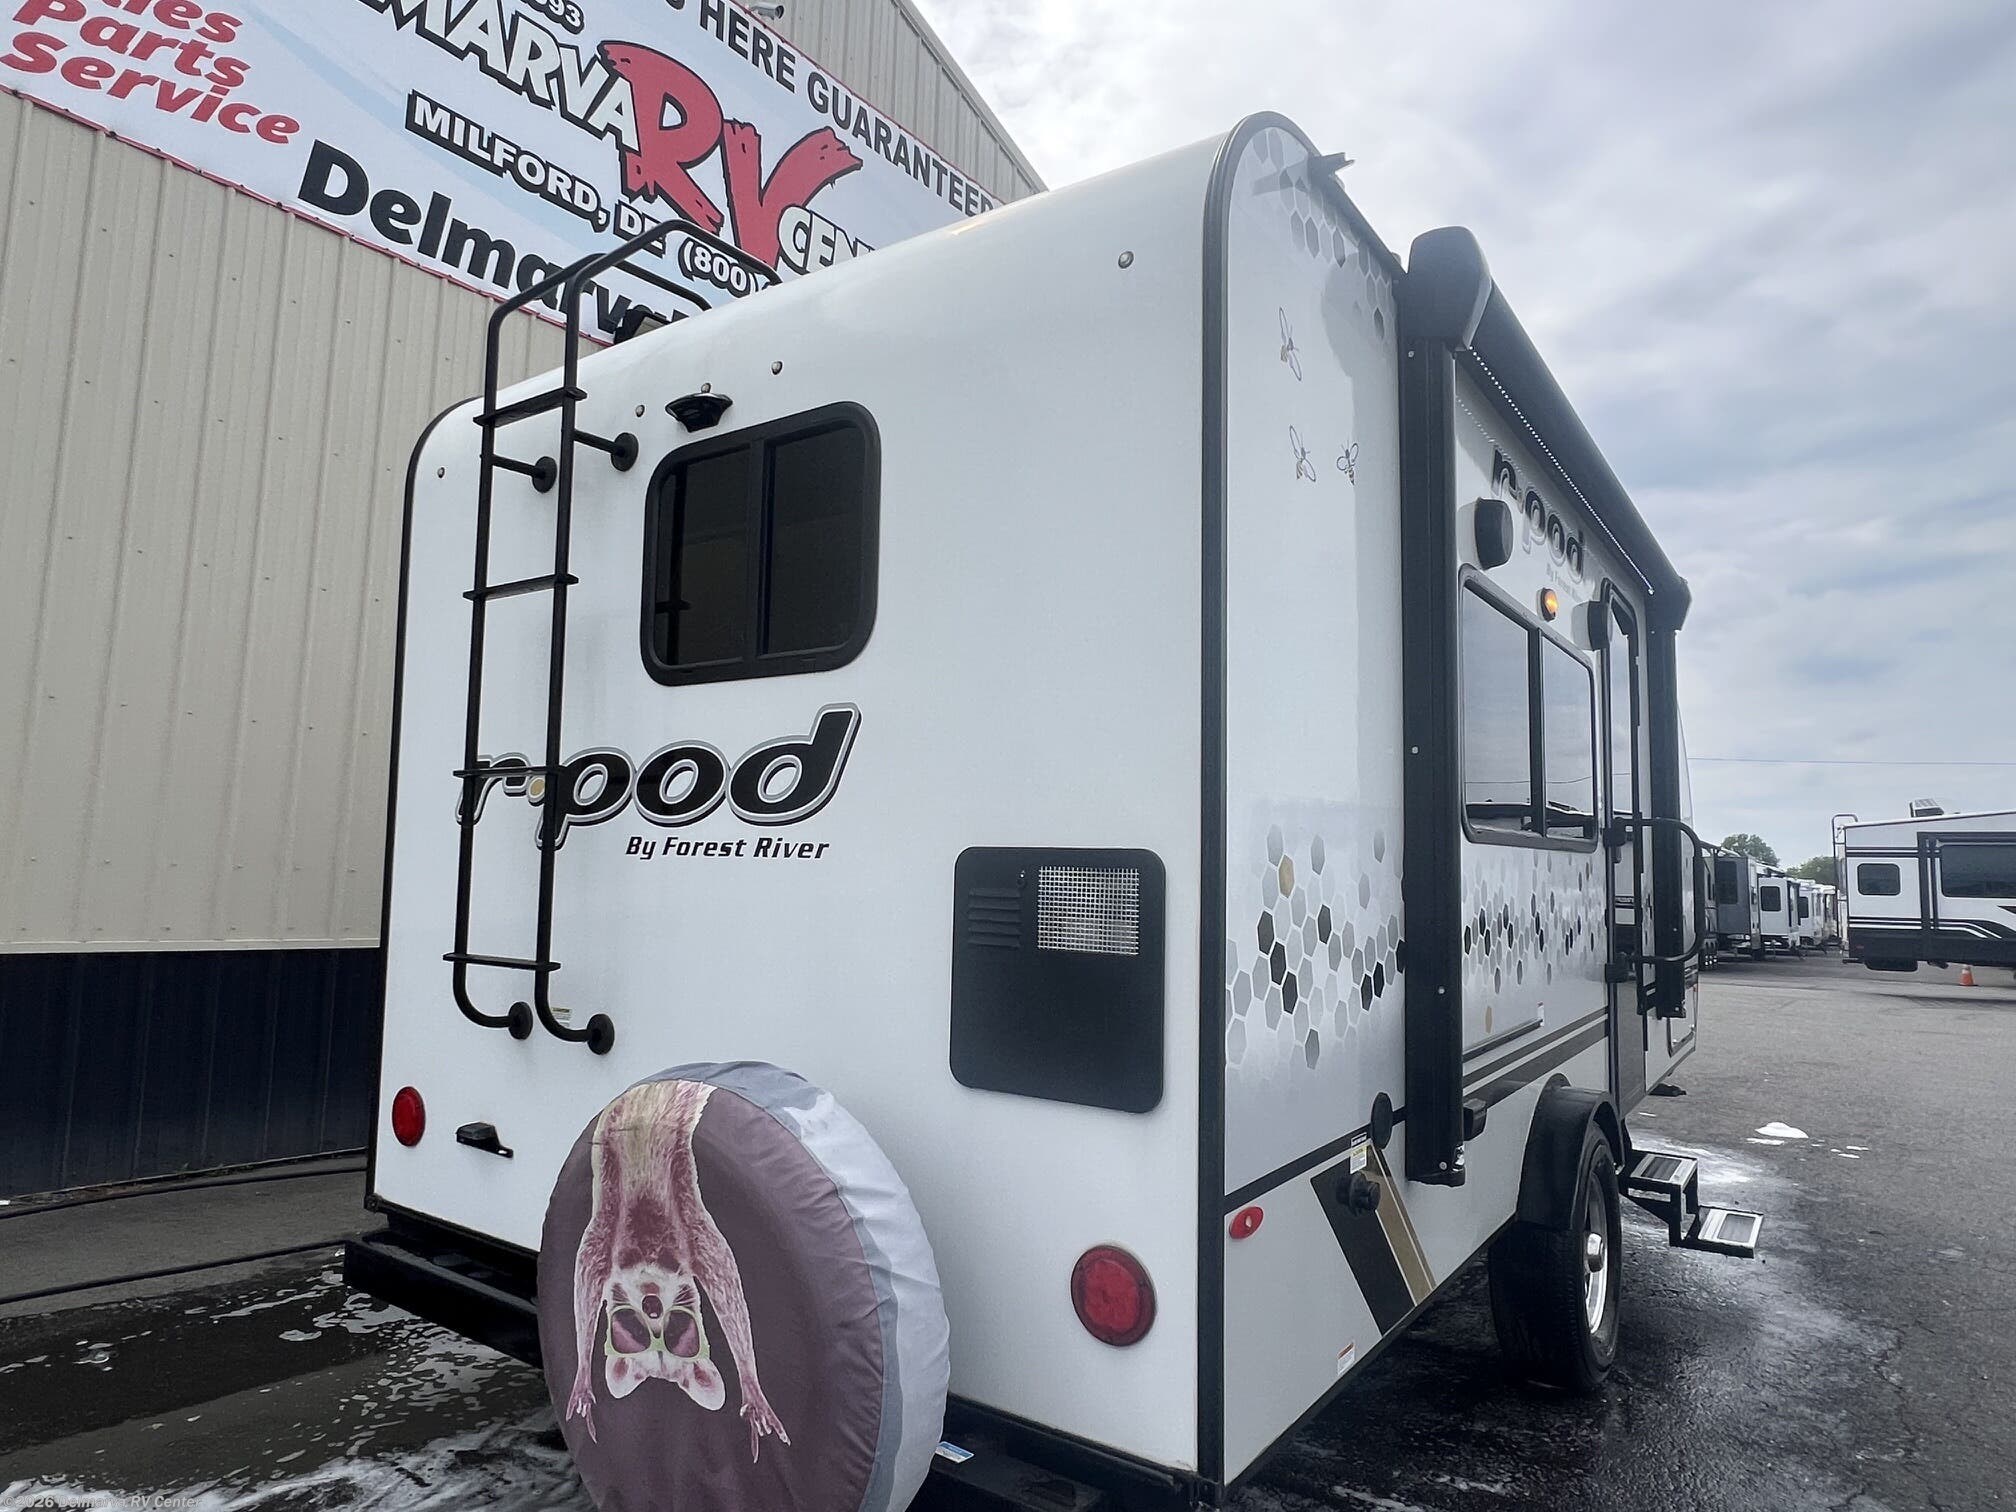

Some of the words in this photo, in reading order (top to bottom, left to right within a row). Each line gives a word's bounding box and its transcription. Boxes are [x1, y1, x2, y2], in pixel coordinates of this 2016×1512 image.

[0, 31, 300, 144] Service
[12, 0, 251, 87] Parts
[699, 0, 797, 94] HERE
[406, 89, 611, 233] MILFORD,
[597, 40, 863, 270] RV
[626, 836, 656, 860] By
[662, 836, 747, 858] Forest
[753, 837, 830, 859] River
